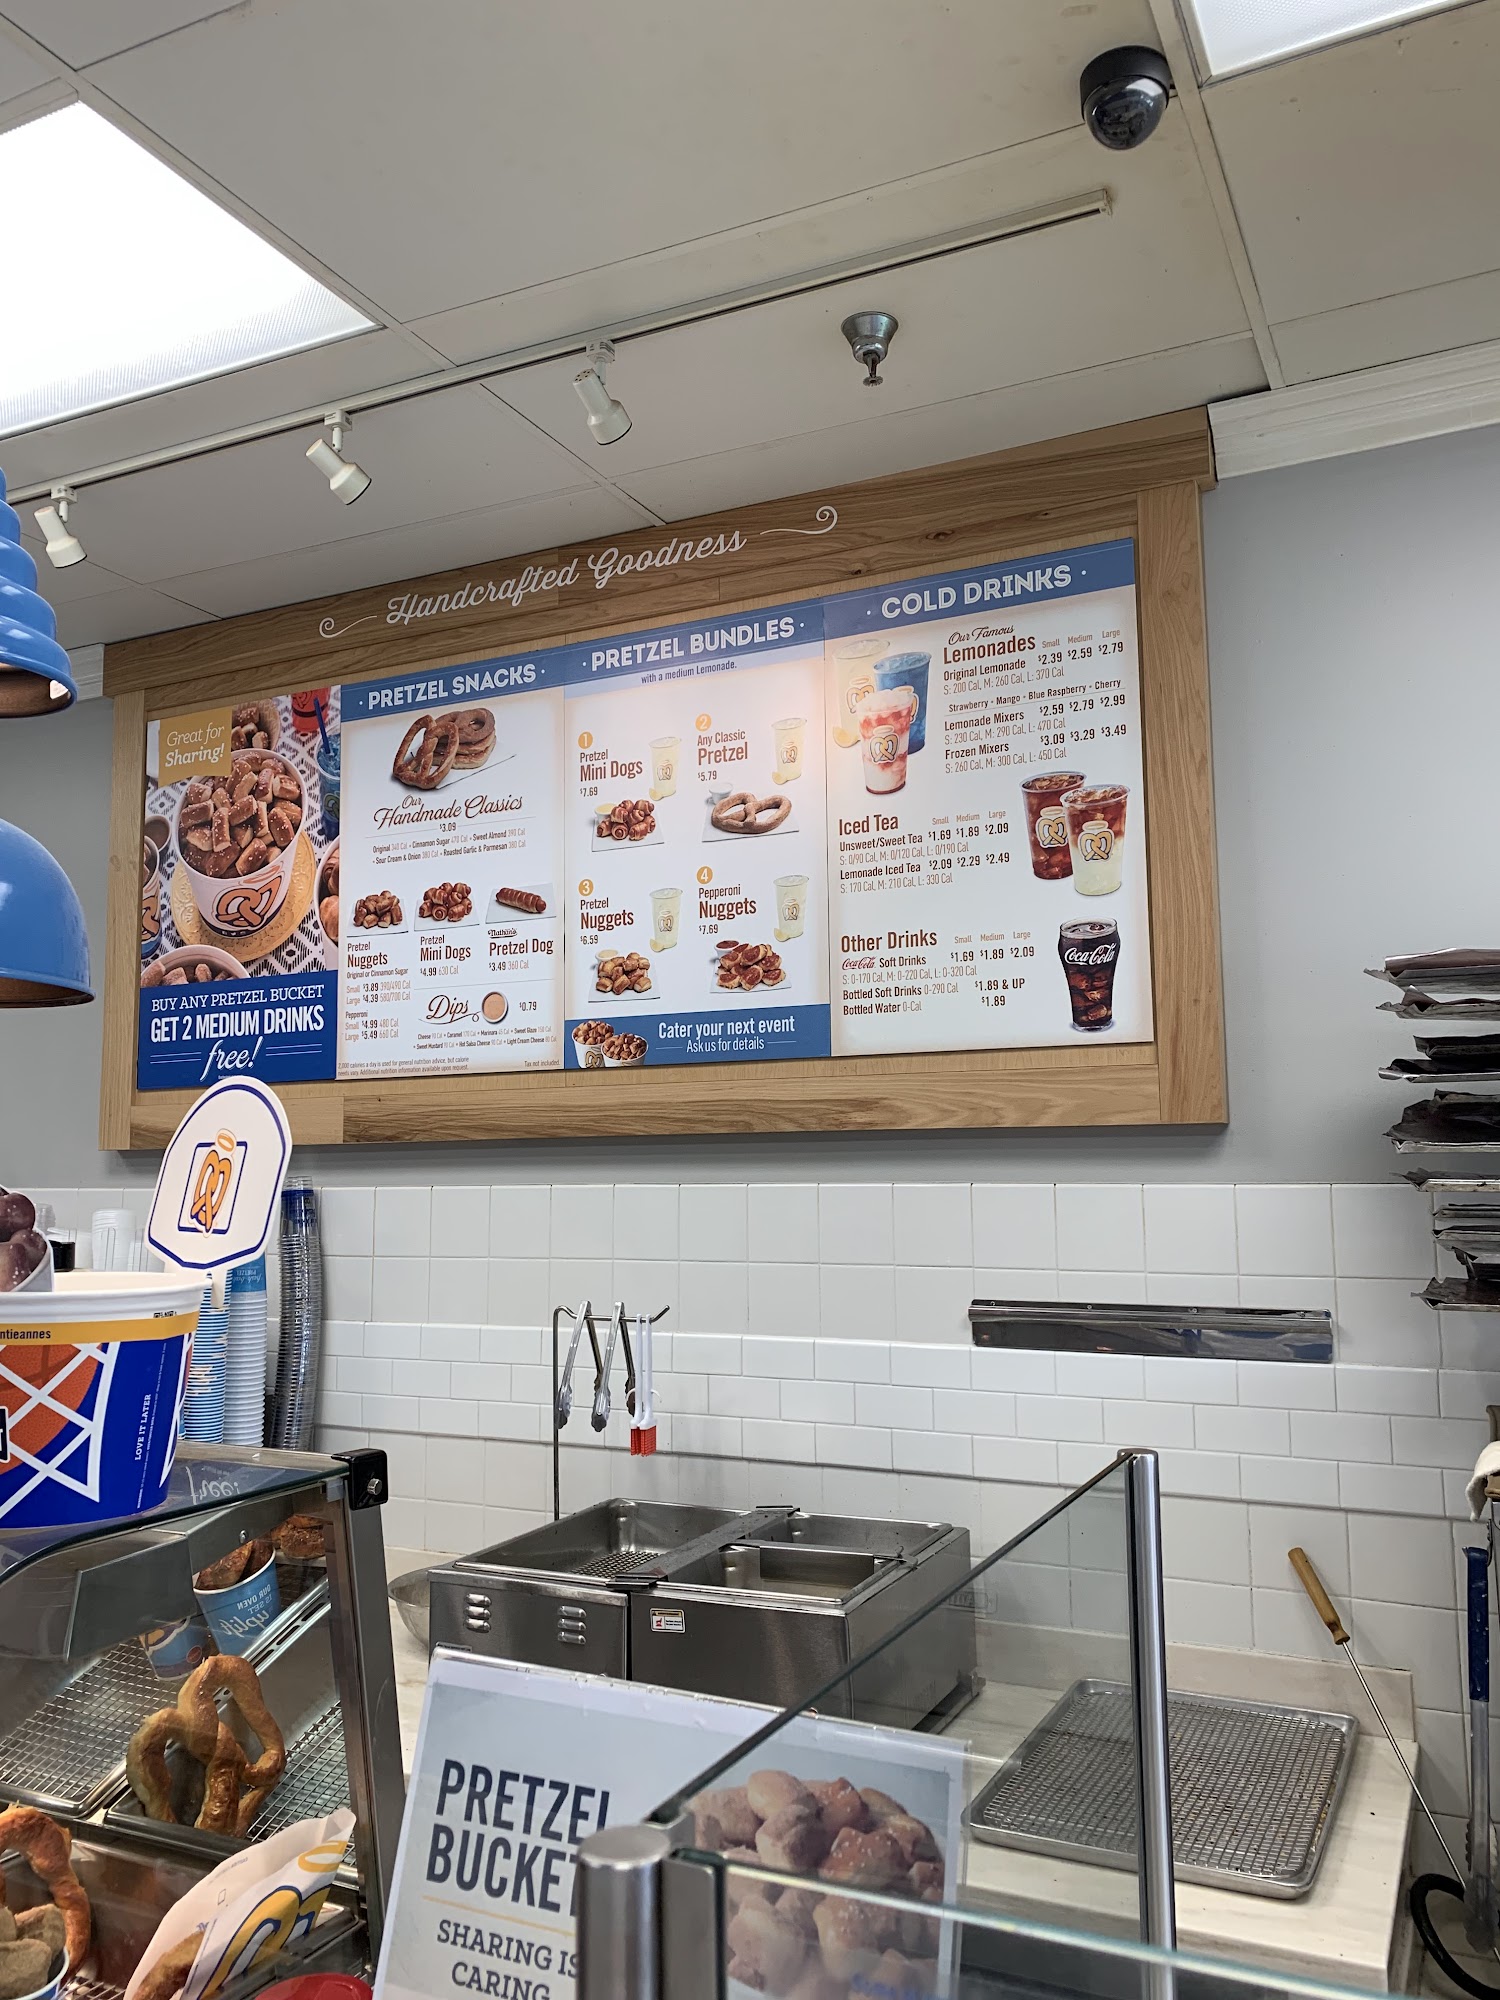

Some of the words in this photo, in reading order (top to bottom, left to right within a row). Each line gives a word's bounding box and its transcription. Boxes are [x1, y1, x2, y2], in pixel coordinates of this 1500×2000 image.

[385, 558, 580, 626] Handcrafted
[587, 530, 747, 590] Goodness
[881, 587, 956, 618] COLD
[964, 565, 1072, 604] DRINKS
[591, 637, 684, 671] PRETZEL
[690, 617, 794, 654] BUNDLES
[948, 632, 970, 646] Our
[972, 625, 1015, 641] Famous
[1042, 639, 1060, 648] Small
[1067, 634, 1092, 644] Medium
[1102, 629, 1120, 639] Large
[943, 635, 1035, 664] Lemonades
[943, 666, 977, 681] Original
[980, 660, 1025, 675] Lemonade
[1038, 652, 1062, 665] $2.39
[1067, 647, 1092, 660] $2.59
[1099, 642, 1124, 655] $2.79
[641, 674, 657, 684] with
[659, 673, 663, 681] a
[665, 668, 694, 680] medium
[696, 661, 737, 674] Lemonade.
[368, 680, 448, 710] PRETZEL
[452, 664, 536, 695] SNACKS
[949, 700, 988, 712] Strawberry
[996, 695, 1020, 705] Mango
[1028, 691, 1045, 700] Blue
[1047, 685, 1086, 697] Raspberry
[1095, 679, 1121, 689] Cherry
[700, 716, 707, 729] 2
[945, 716, 991, 731] Lemonade
[994, 711, 1024, 723] Mixers
[1039, 704, 1064, 716] $2.59
[1069, 699, 1094, 711] $2.79
[1100, 694, 1125, 707] $2.99
[167, 728, 202, 747] Great
[205, 722, 225, 744] for
[697, 734, 712, 748] Any
[715, 729, 746, 743] Classic
[945, 745, 976, 759] Frozen
[979, 742, 1009, 754] Mixers
[1040, 733, 1065, 746] $3.09
[1070, 729, 1095, 741] $3.29
[1101, 724, 1126, 737] $3.49
[165, 743, 225, 767] Sharing!
[580, 749, 608, 763] Pretzel
[698, 742, 748, 766] Pretzel
[580, 762, 606, 782] Mini
[611, 760, 643, 779] Dogs
[698, 771, 717, 781] $5.79
[402, 794, 422, 809] Our
[580, 787, 598, 797] $7.69
[373, 799, 462, 830] Handmade
[464, 794, 523, 819] Classics
[932, 817, 949, 825] Small
[956, 813, 980, 822] Medium
[989, 810, 1006, 819] Large
[439, 823, 456, 832] $3.09
[839, 816, 869, 836] Iced
[874, 814, 898, 830] Tea
[840, 835, 905, 852] Unsweet/Sweet
[908, 833, 922, 843] Tea
[928, 829, 951, 842] $1.69
[956, 826, 979, 837] $1.89
[985, 822, 1009, 834] $2.09
[701, 868, 708, 881] 4
[840, 865, 882, 880] Lemonade
[885, 864, 903, 875] Iced
[906, 862, 920, 872] Tea
[929, 859, 952, 870] $2.09
[957, 855, 980, 868] $2.29
[986, 852, 1010, 864] $2.49
[583, 881, 590, 894] 3
[699, 884, 741, 901] Pepperoni
[580, 898, 609, 910] Pretzel
[699, 898, 756, 921] Nuggets
[581, 910, 634, 932] Nuggets
[699, 924, 718, 935] $7.69
[348, 942, 370, 951] Pretzel
[420, 935, 444, 946] Pretzel
[489, 940, 529, 956] Pretzel
[533, 938, 553, 954] Dog
[580, 935, 598, 945] $6.59
[841, 935, 882, 953] Other
[888, 929, 937, 949] Drinks
[955, 935, 972, 944] Small
[981, 932, 1004, 942] Medium
[1013, 931, 1031, 940] Large
[347, 953, 388, 969] Nuggets
[420, 947, 442, 962] Mini
[445, 946, 471, 962] Dogs
[879, 957, 896, 968] Soft
[899, 955, 926, 966] Drinks
[951, 951, 974, 962] $1.69
[980, 949, 1004, 960] $1.89
[1010, 946, 1035, 958] $2.09
[347, 971, 364, 979] Original
[395, 968, 408, 976] Sugar
[420, 967, 436, 976] $4.99
[489, 962, 506, 971] $3.49
[152, 998, 179, 1012] BUY
[180, 995, 207, 1009] ANY
[211, 989, 267, 1006] PRETZEL
[270, 985, 324, 1000] BUCKET
[363, 984, 378, 992] $3.89
[843, 987, 872, 1000] Bottled
[875, 987, 892, 998] Soft
[894, 986, 921, 996] Drinks
[975, 979, 998, 991] $1.89
[1002, 980, 1008, 990] &
[1013, 978, 1025, 989] UP
[347, 997, 360, 1005] Large
[363, 994, 378, 1003] $4.39
[426, 994, 469, 1023] Dips
[520, 1002, 537, 1011] $0.79
[843, 1003, 873, 1015] Bottled
[875, 1003, 901, 1014] Water
[982, 996, 1005, 1007] $1.89
[151, 1017, 179, 1042] GET
[182, 1016, 192, 1040] 2
[196, 1009, 259, 1039] MEDIUM
[264, 1005, 324, 1034] DRINKS
[345, 1011, 368, 1019] Pepperoni
[345, 1022, 359, 1030] Small
[362, 1020, 378, 1029] $4.99
[345, 1033, 359, 1041] Large
[362, 1031, 377, 1039] $5.49
[658, 1022, 693, 1038] Cater
[696, 1022, 724, 1040] your
[727, 1020, 754, 1035] next
[758, 1016, 794, 1032] event
[718, 1038, 731, 1051] for
[733, 1036, 765, 1051] details
[200, 1036, 263, 1081] free!
[141, 1394, 151, 1423] LATER
[139, 1425, 146, 1434] IT
[135, 1437, 144, 1460] LOVE
[435, 1758, 610, 1845] PRETZEL
[437, 1919, 552, 1970] SHARING
[452, 1961, 550, 2000] CARING
